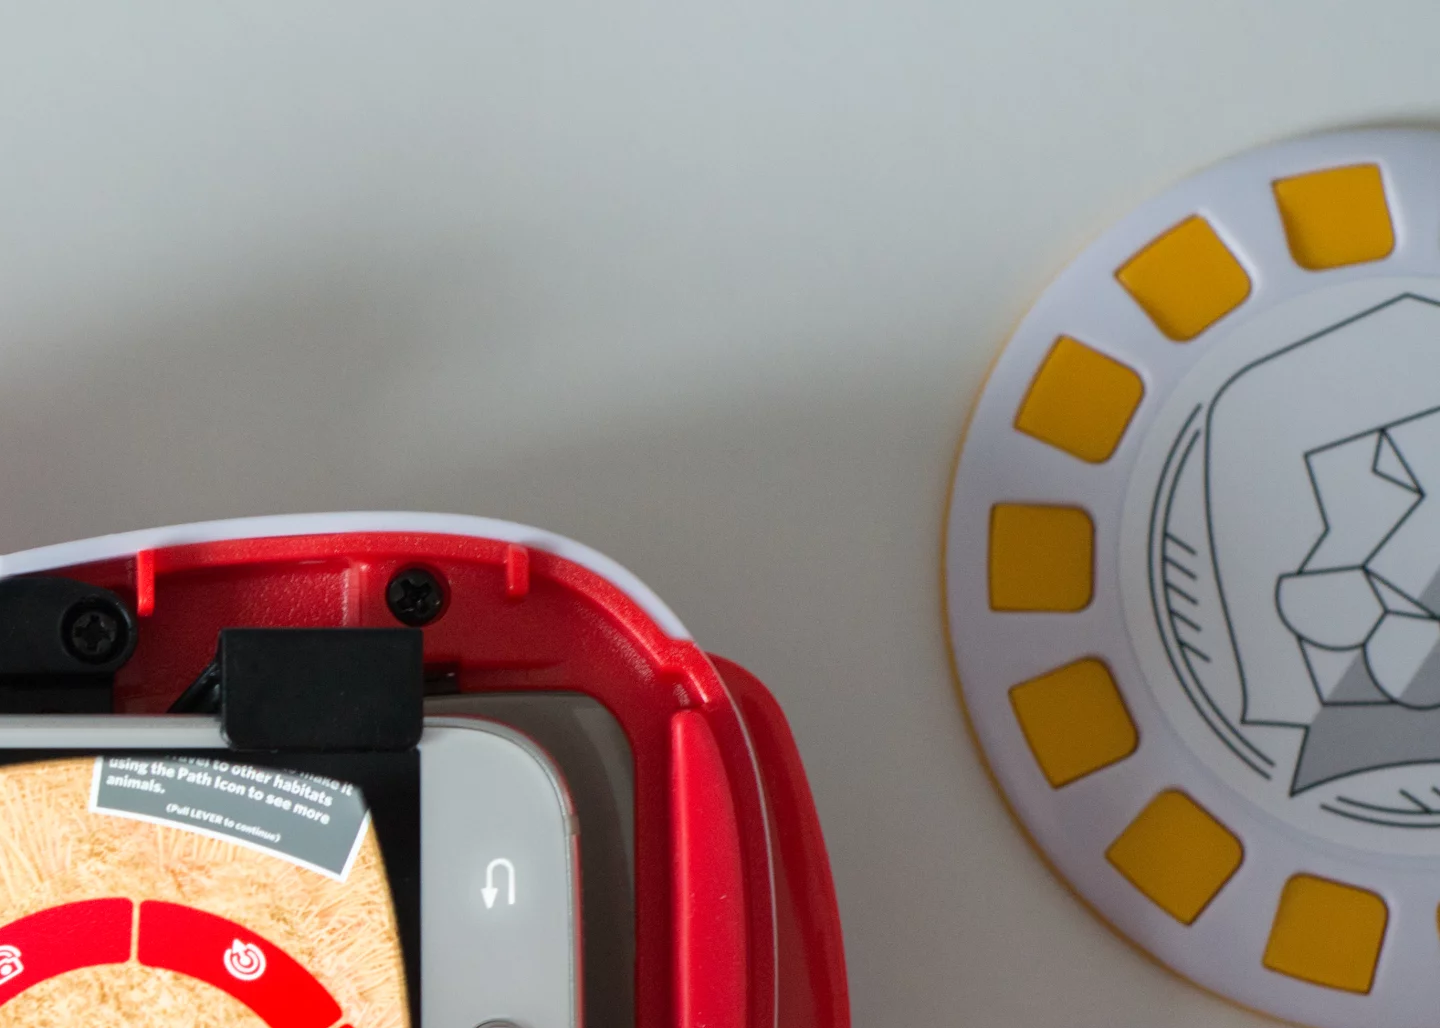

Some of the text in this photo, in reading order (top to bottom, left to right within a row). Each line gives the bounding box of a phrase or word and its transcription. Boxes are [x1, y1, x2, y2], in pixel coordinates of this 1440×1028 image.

[106, 774, 166, 794] animals.
[108, 757, 331, 825] using the Path Icon to see more
[212, 759, 229, 772] to
[231, 764, 273, 785] other
[273, 774, 333, 807] habitats
[340, 781, 354, 797] it
[165, 803, 282, 844] (Pull LEVER to continue)
